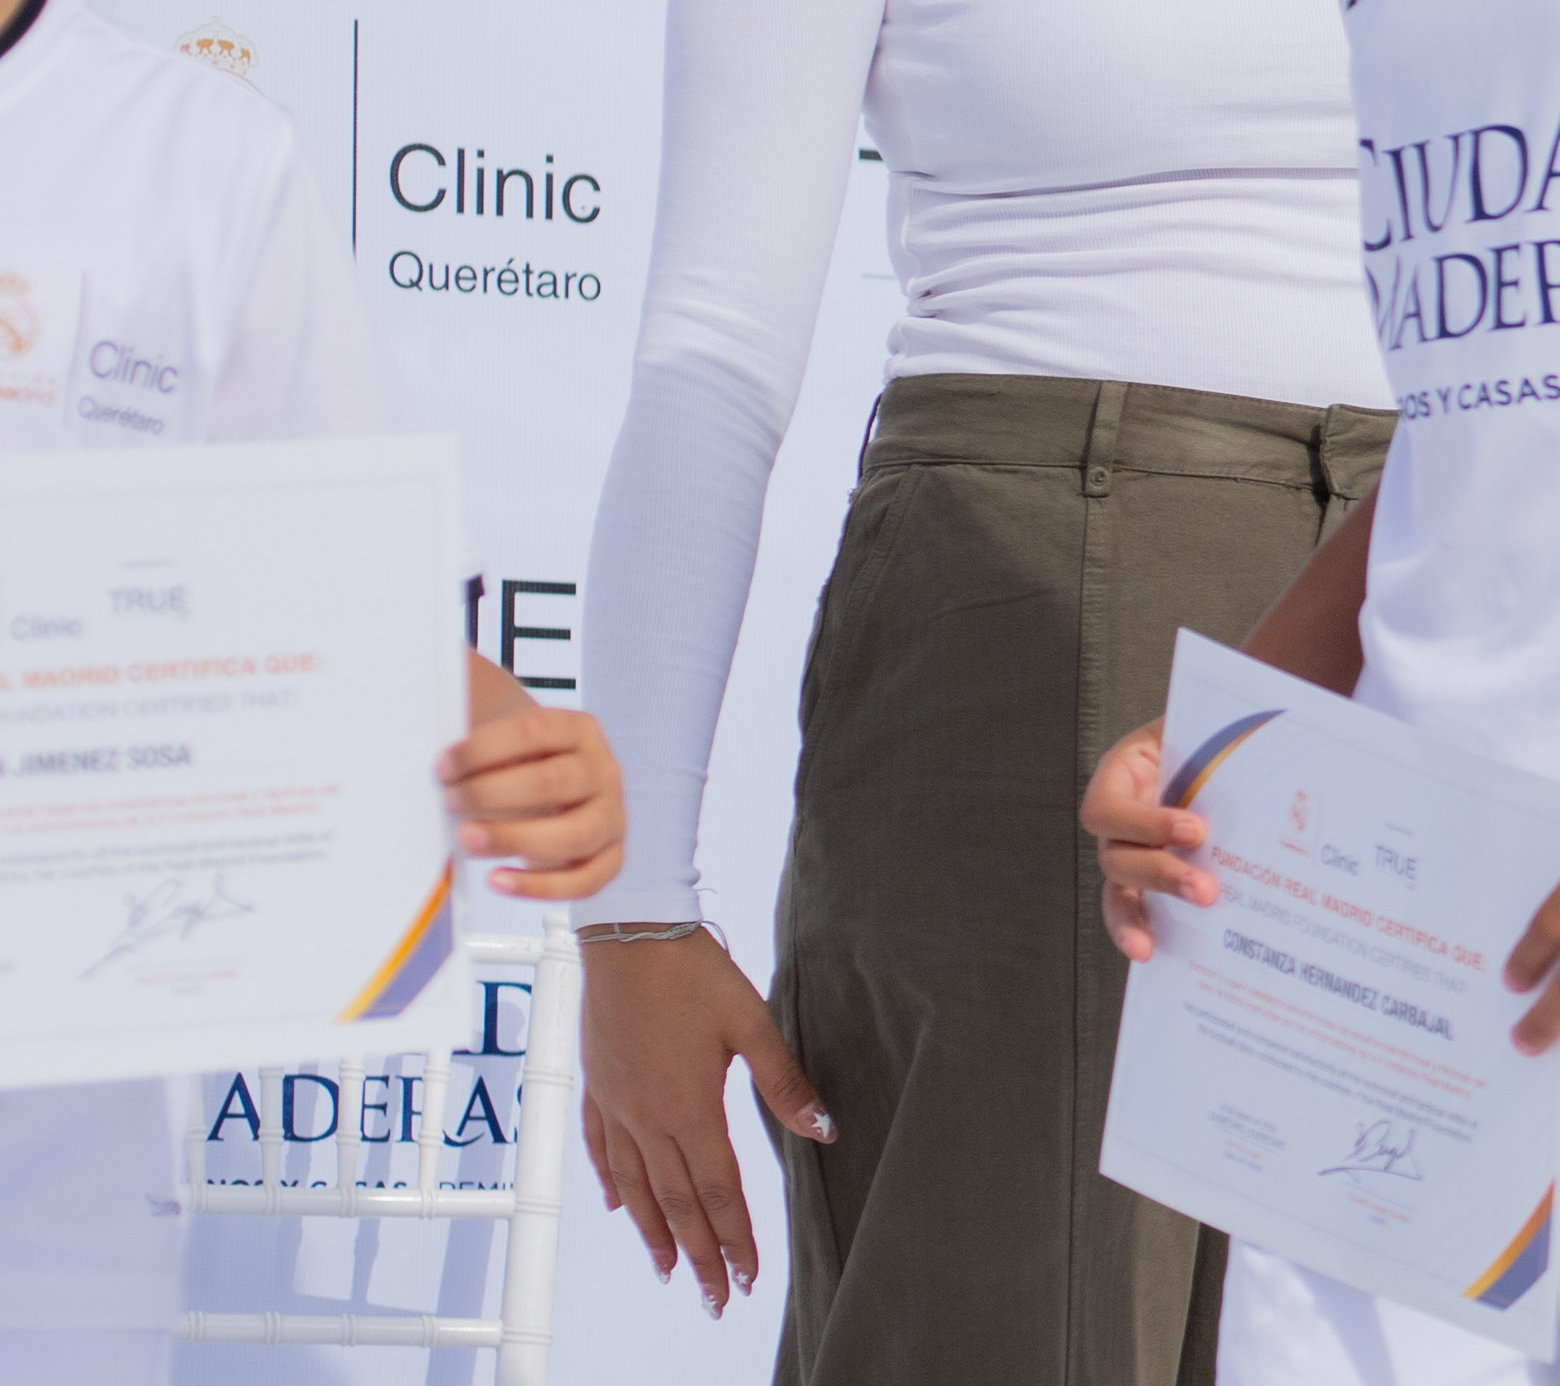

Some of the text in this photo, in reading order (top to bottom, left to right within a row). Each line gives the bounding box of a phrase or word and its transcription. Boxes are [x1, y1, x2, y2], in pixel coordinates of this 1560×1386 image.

[389, 143, 602, 223] Clinic
[389, 250, 602, 302] Querétaro
[89, 339, 179, 395] Clinic
[1435, 387, 1452, 412] Y
